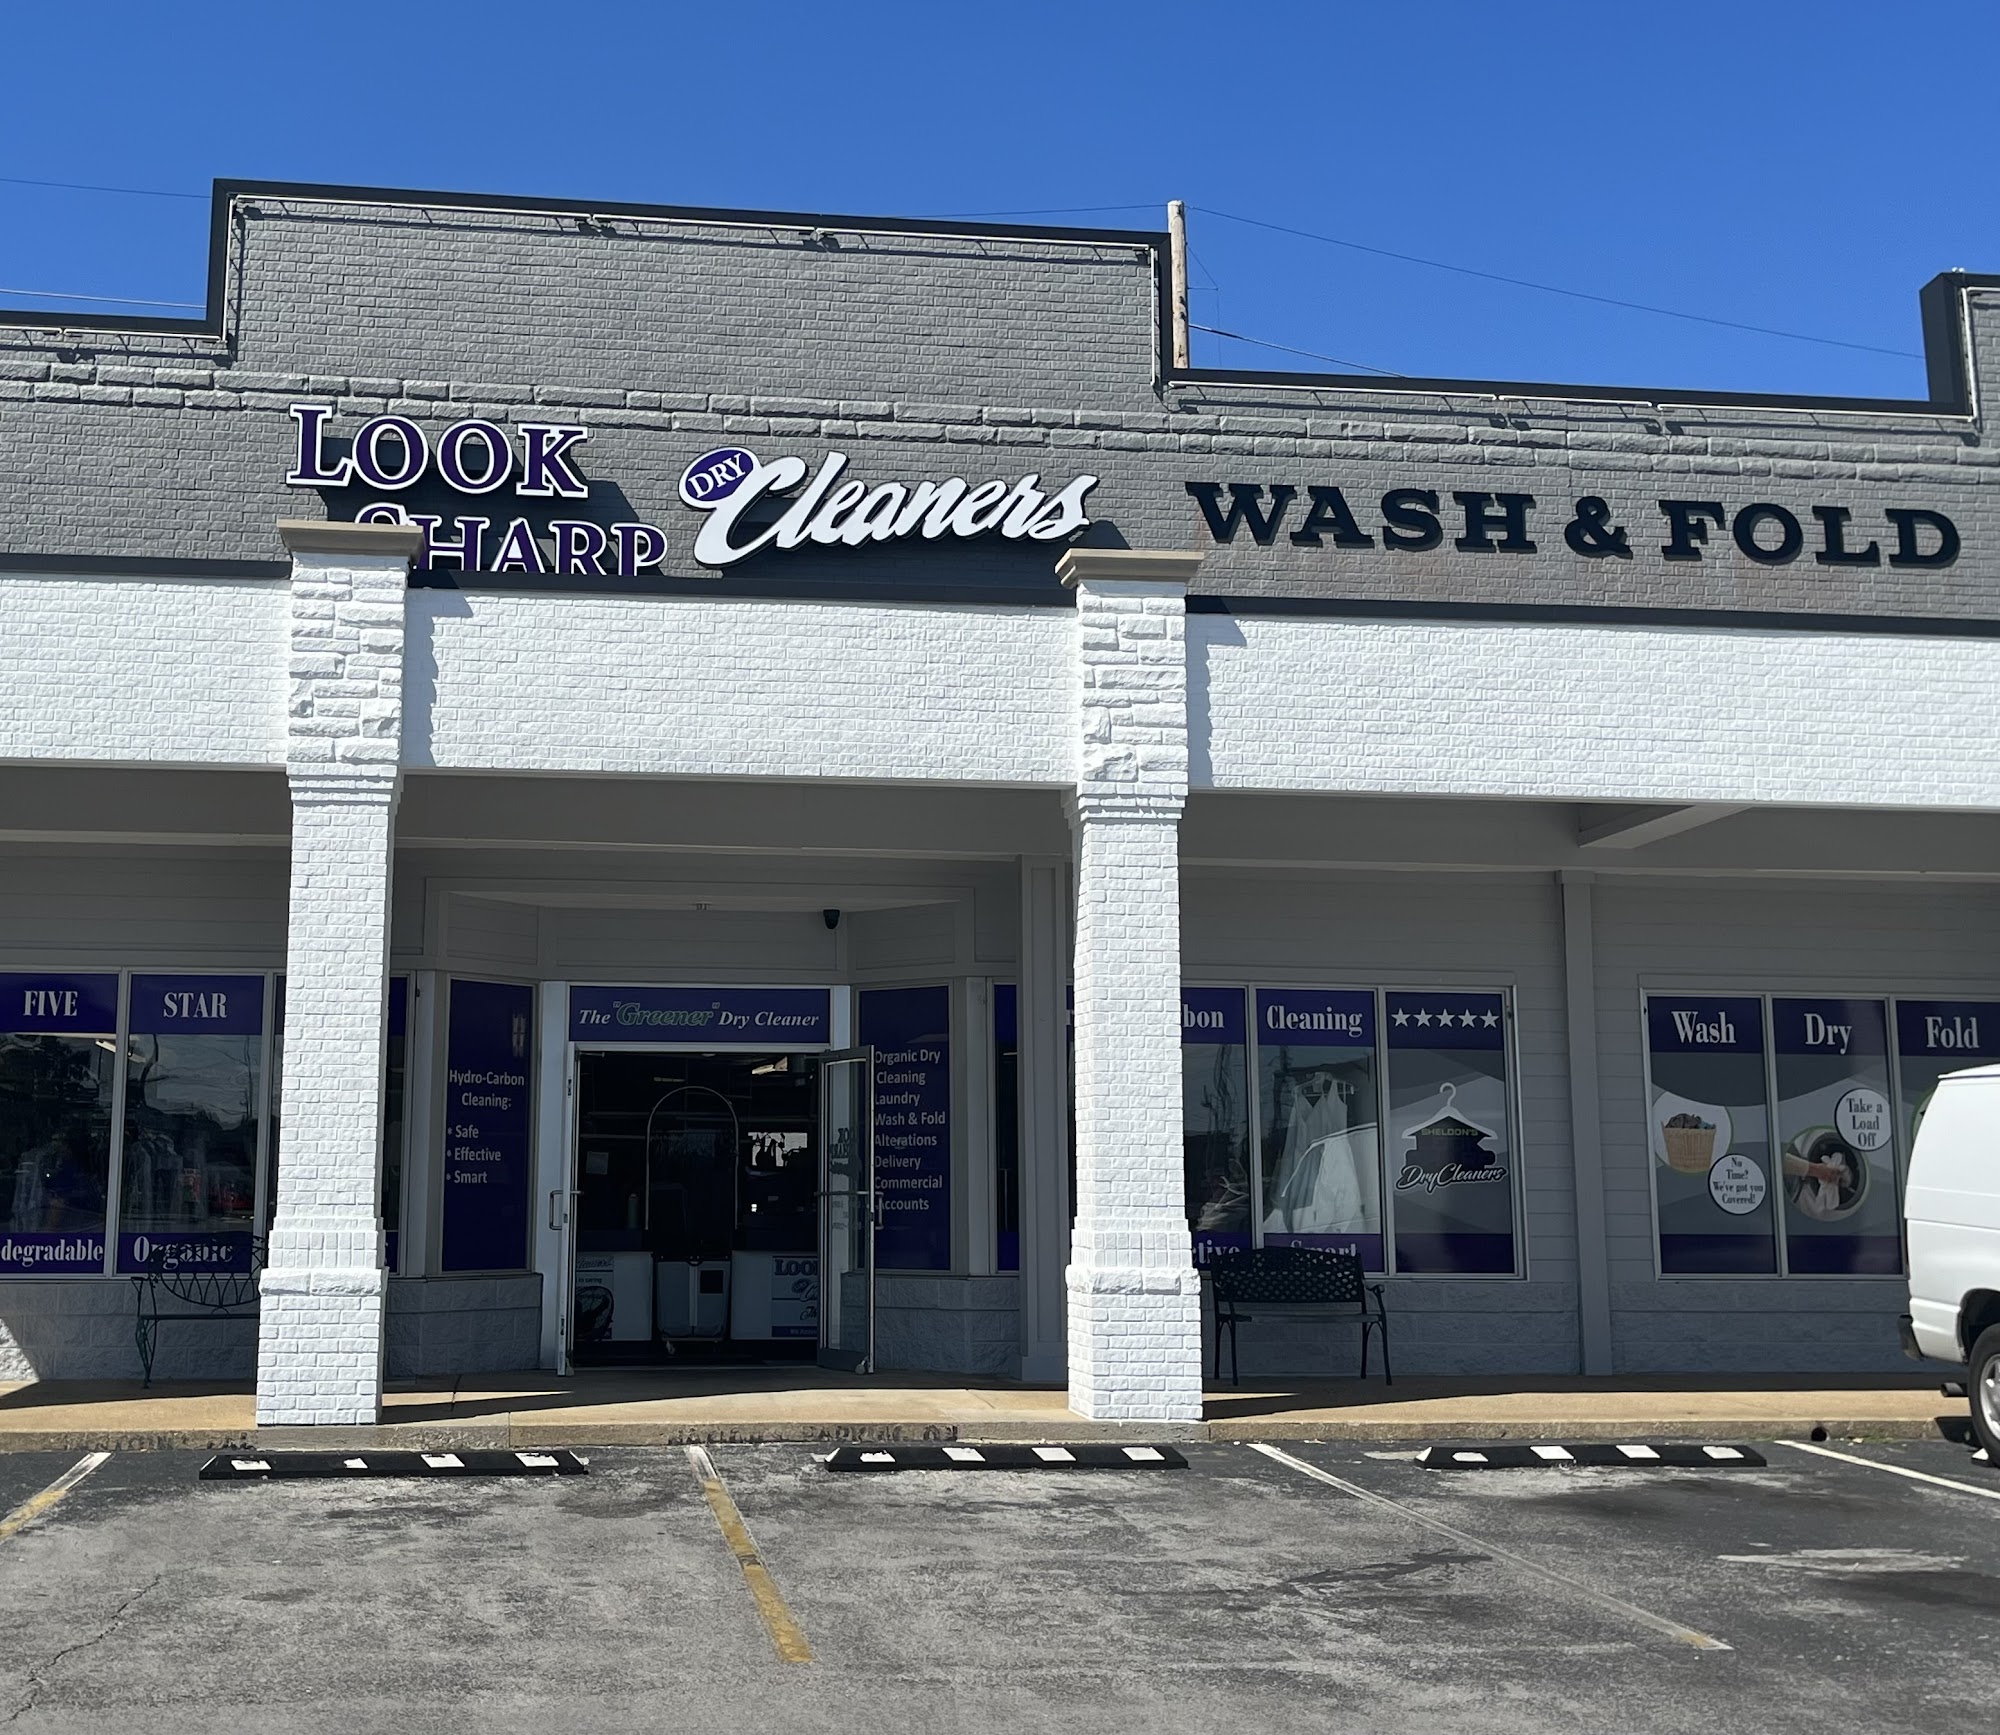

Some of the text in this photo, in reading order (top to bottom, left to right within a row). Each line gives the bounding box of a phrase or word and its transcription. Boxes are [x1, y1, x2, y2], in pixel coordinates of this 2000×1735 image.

[286, 402, 589, 499] LOOK
[687, 450, 1098, 567] DRY Cleaners
[1184, 481, 1961, 569] WASH & FOLD
[353, 501, 669, 577] HARP
[22, 990, 79, 1018] FIVE
[162, 991, 228, 1019] STAR
[578, 1008, 612, 1026] The
[717, 1010, 751, 1030] Dry
[753, 1011, 820, 1028] Cleaner
[1266, 1004, 1364, 1038] Cleaning
[1671, 1010, 1737, 1044] Wash
[1803, 1012, 1853, 1055] Dry
[1924, 1016, 1980, 1049] Fold
[919, 1048, 942, 1065] Dry
[449, 1068, 526, 1087] Hydro-Carbon
[876, 1069, 927, 1086] Cleaning
[461, 1091, 512, 1111] Cleaning:
[875, 1090, 922, 1107] Laundry
[1846, 1098, 1883, 1113] Take a
[875, 1110, 946, 1126] Wash & Fold
[1852, 1115, 1880, 1130] Load
[454, 1123, 480, 1139] Safe
[875, 1132, 938, 1147] Alterations
[1857, 1132, 1877, 1147] Off
[454, 1145, 502, 1161] Effective
[875, 1154, 922, 1170] Delivery
[453, 1168, 488, 1184] Smart
[875, 1174, 943, 1190] Commercial
